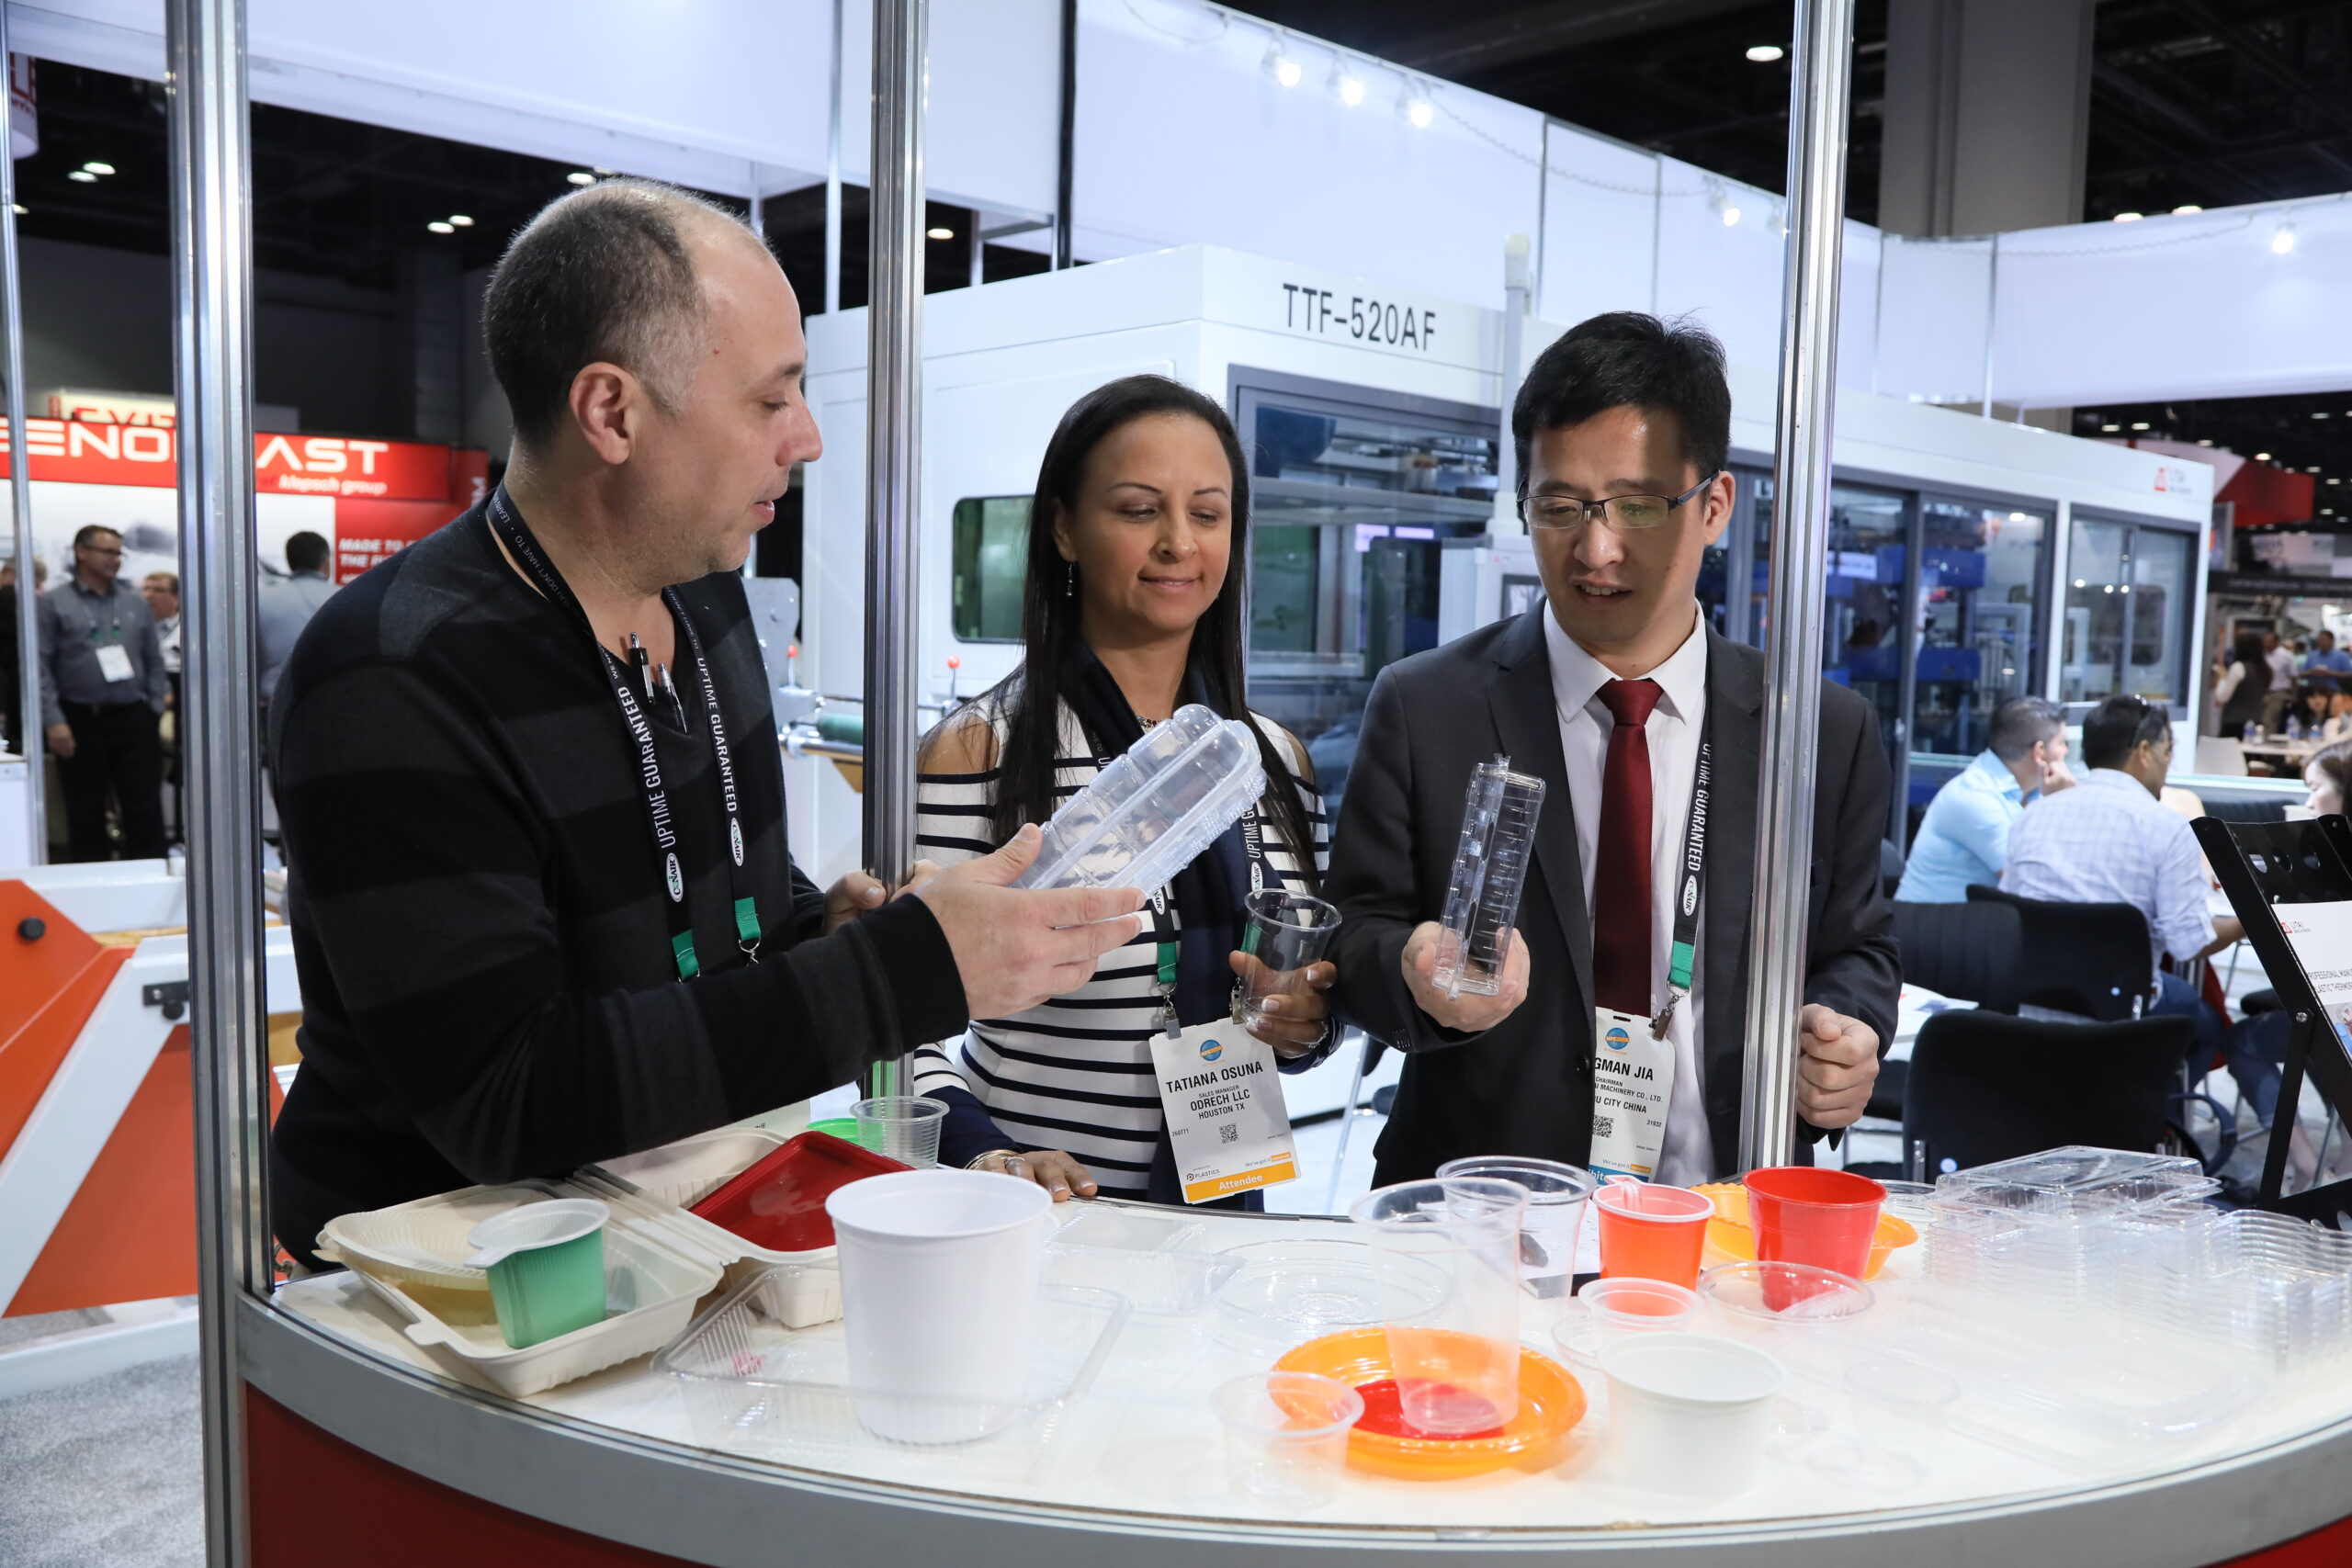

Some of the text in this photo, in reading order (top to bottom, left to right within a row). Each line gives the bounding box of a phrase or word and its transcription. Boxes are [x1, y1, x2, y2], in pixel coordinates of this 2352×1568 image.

[1283, 283, 1436, 351] TTF-520AF
[342, 479, 388, 495] group
[514, 536, 525, 548] TO
[524, 547, 539, 569] HAVE
[697, 657, 738, 812] UPTIME GUARANTEED
[617, 686, 676, 849] UPTIME GUARANTEED
[1243, 820, 1261, 859] UPTIME
[1688, 789, 1709, 872] GUARANTEED
[1166, 1061, 1263, 1093] TATIANA OSUNA
[1596, 1077, 1623, 1087] CHAIRMAN
[1634, 1066, 1654, 1080] JIA
[1190, 1089, 1250, 1111] ODRECH LLC
[1199, 1085, 1240, 1099] SALES MANAGER
[1600, 1084, 1635, 1097] MACHINERY
[1650, 1094, 1663, 1102] LTD.
[1199, 1102, 1245, 1120] HOUSTON TX
[1604, 1098, 1622, 1108] CITY
[1623, 1101, 1646, 1113] CHINA
[1172, 1128, 1189, 1137] 260771
[1194, 1168, 1220, 1179] PLASTICS
[1218, 1175, 1263, 1190] Attendee
